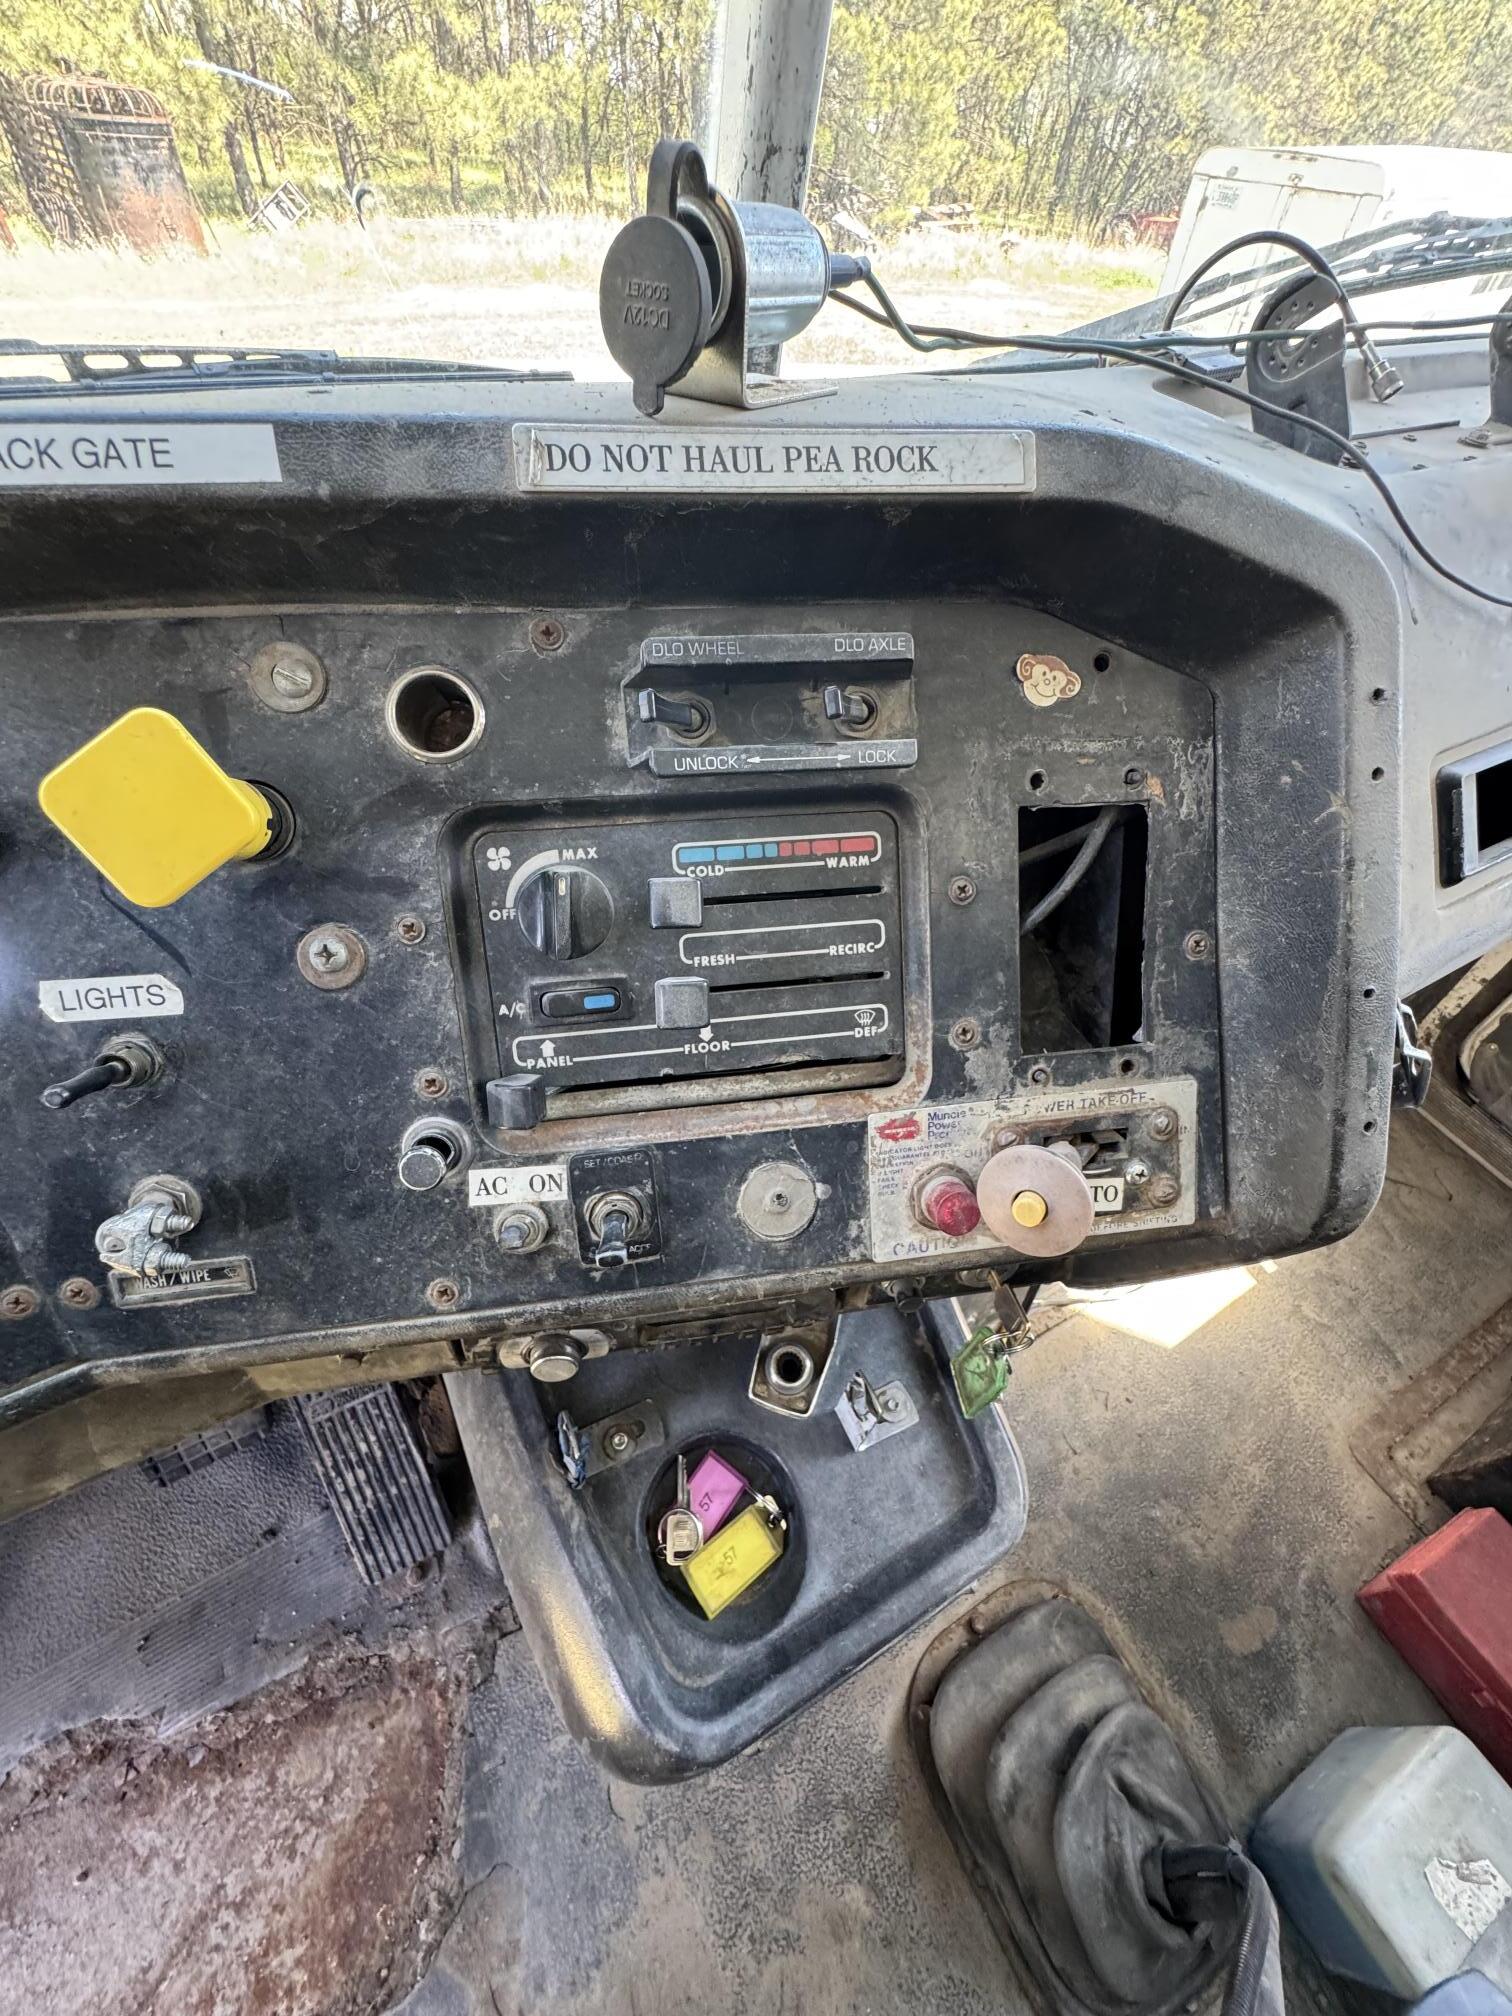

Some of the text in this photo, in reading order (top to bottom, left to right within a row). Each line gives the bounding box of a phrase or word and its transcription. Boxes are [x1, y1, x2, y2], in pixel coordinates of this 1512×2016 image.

[626, 280, 670, 301] SOCKET
[72, 438, 174, 469] GATE
[545, 443, 939, 474] DO NOT HAUL PEA ROCK
[652, 641, 744, 657] DLO WHEEL
[835, 637, 906, 652] DLO AXLE
[674, 749, 896, 771] UNLOCK LOCK
[562, 847, 599, 861] MAX
[687, 854, 870, 878] COLD WARM
[488, 907, 517, 921] OFF
[693, 942, 876, 967] FRESH RECIRC
[58, 983, 167, 1012] LIGHTS
[499, 1002, 526, 1018] A/C
[526, 1025, 879, 1070] PANEL FLOOR DEF
[475, 1172, 564, 1197] AC ON
[1092, 1185, 1119, 1203] TO
[699, 1492, 714, 1512] 57
